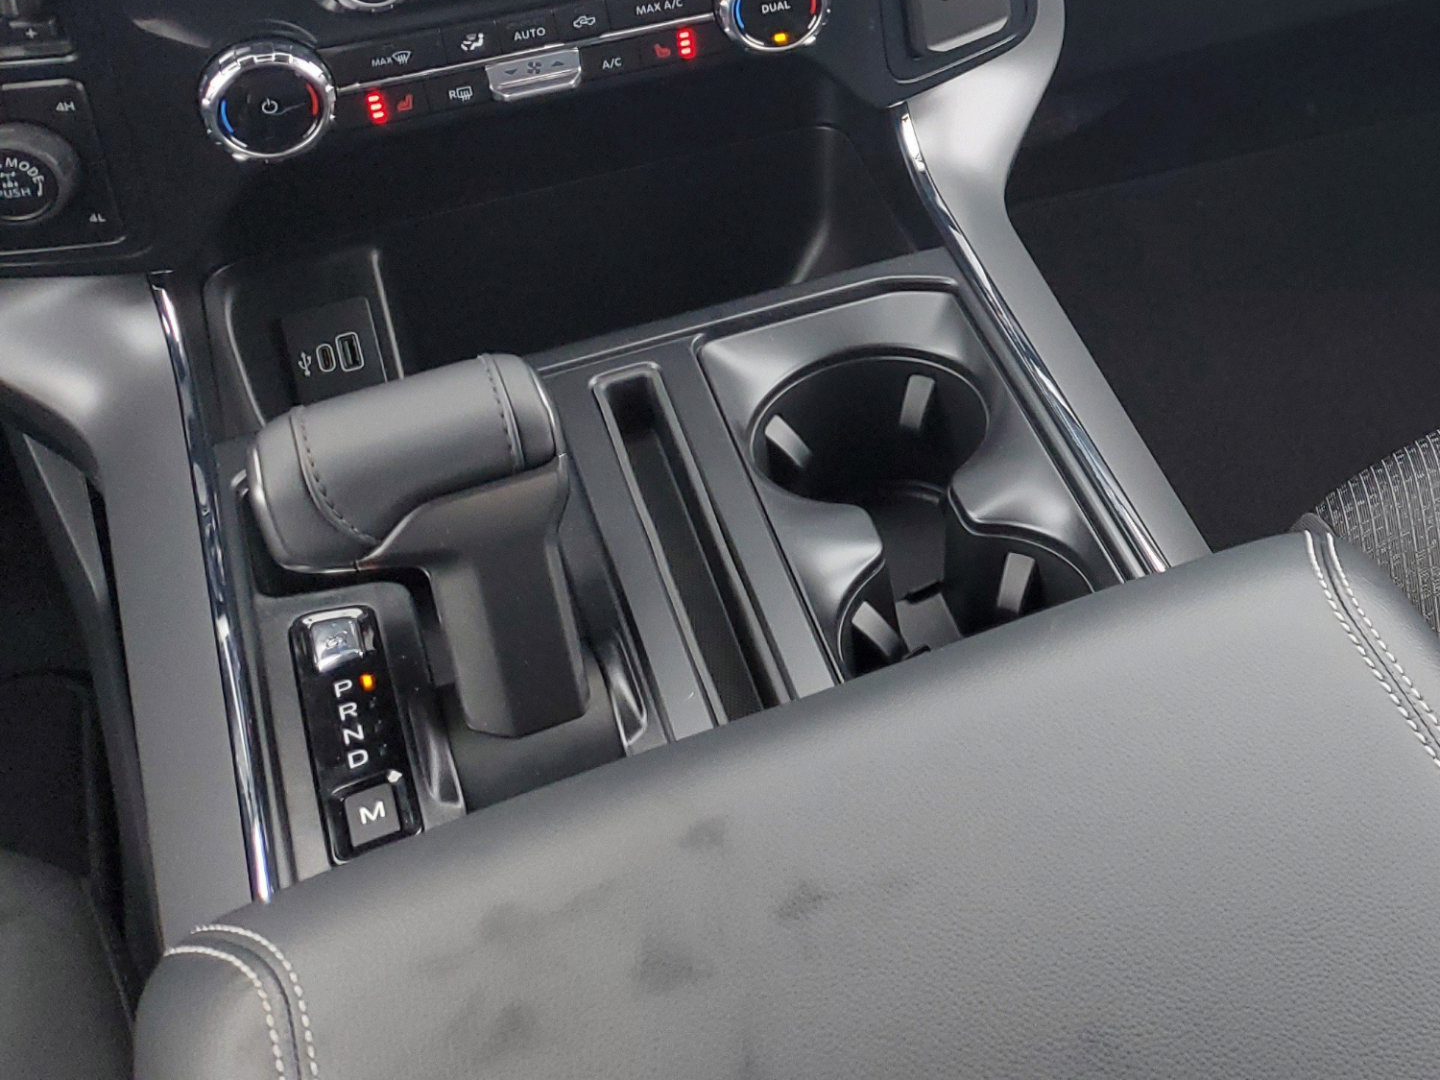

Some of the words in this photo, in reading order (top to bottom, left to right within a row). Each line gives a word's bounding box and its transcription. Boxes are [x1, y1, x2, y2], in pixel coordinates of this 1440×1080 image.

[636, 2, 661, 16] MAX
[761, 1, 791, 15] DUAL
[513, 27, 547, 42] AUTO
[372, 57, 393, 68] MAX
[602, 57, 622, 70] A/C
[56, 101, 76, 112] 4H
[5, 157, 45, 185] MODE
[89, 213, 107, 223] 4L
[333, 679, 353, 698] P
[338, 702, 358, 721] R
[342, 724, 365, 746] N
[347, 749, 369, 769] D
[358, 801, 386, 825] M
